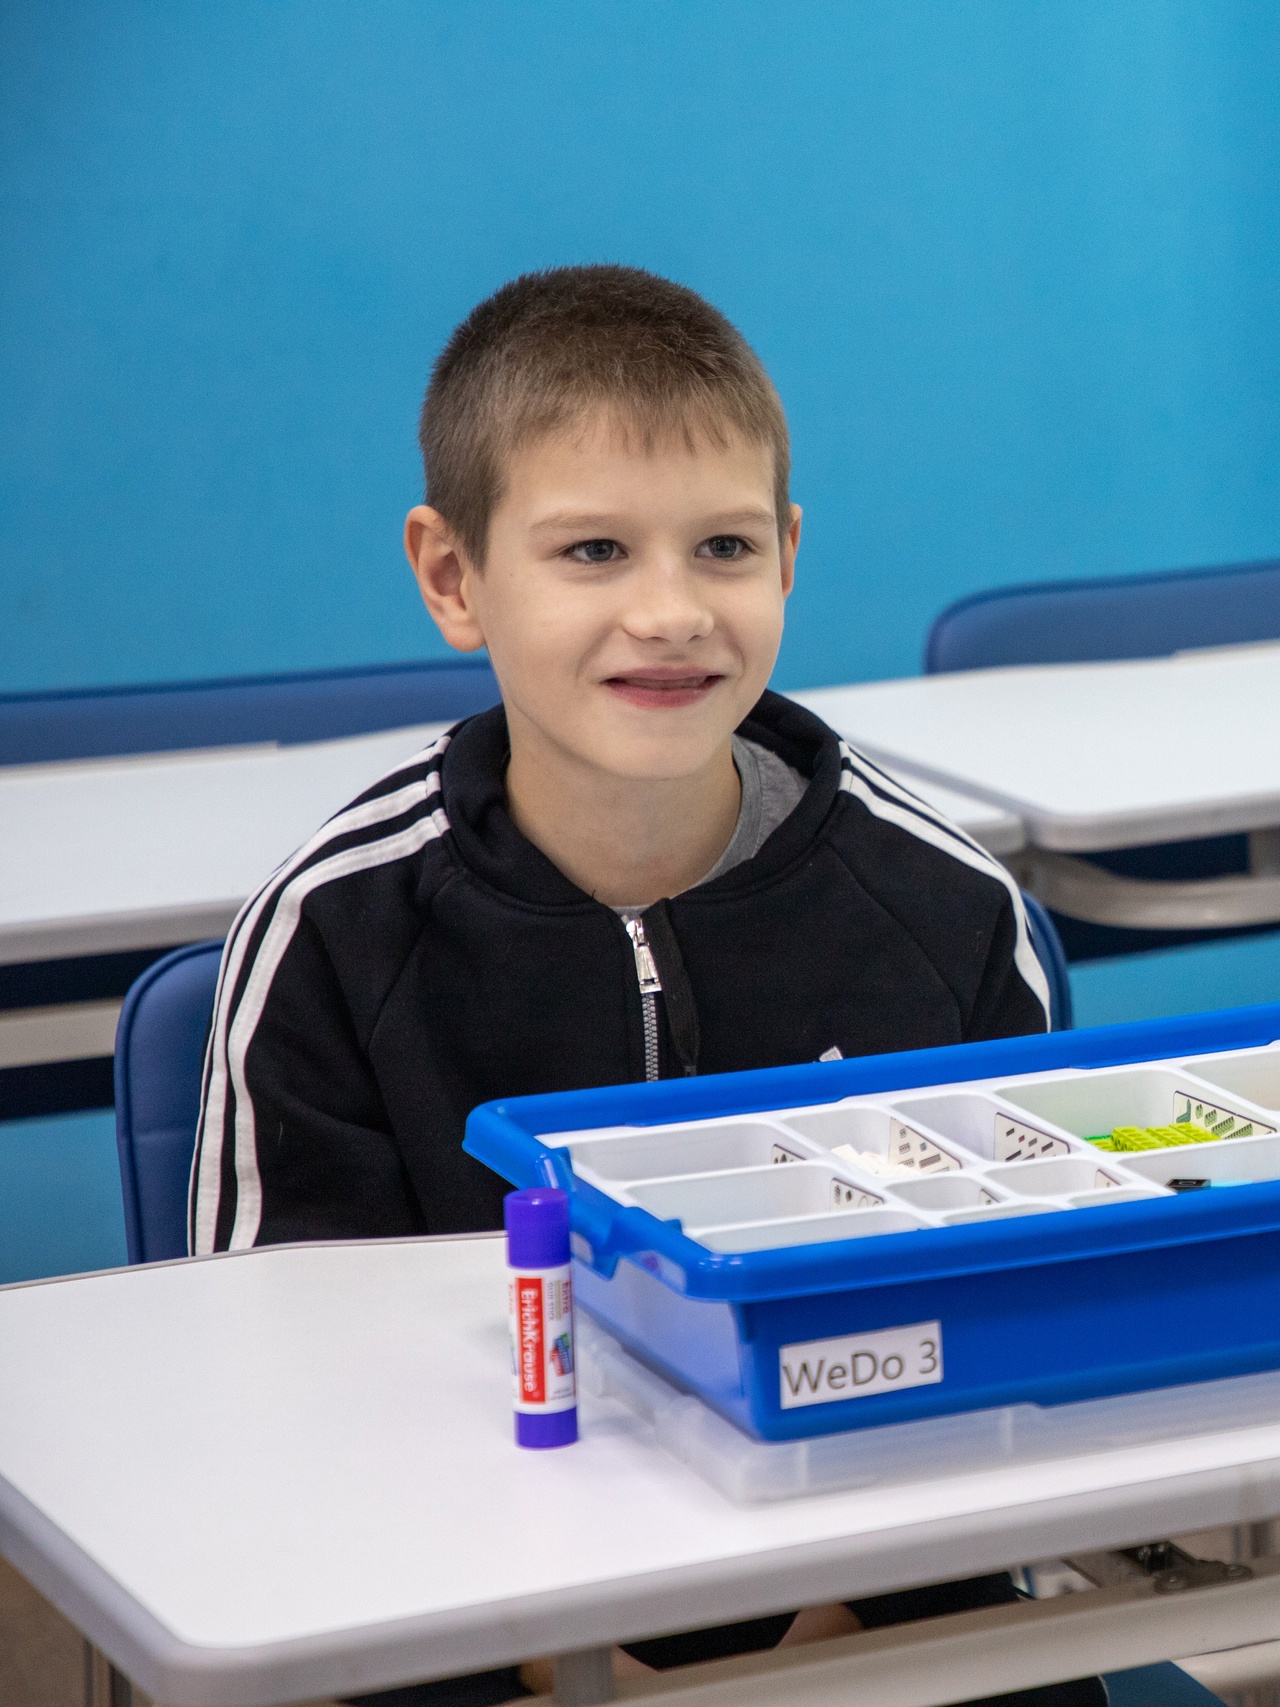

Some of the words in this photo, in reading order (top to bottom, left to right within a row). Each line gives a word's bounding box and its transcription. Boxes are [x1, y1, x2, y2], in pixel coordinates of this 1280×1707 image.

[520, 1288, 540, 1393] ErichKrause
[782, 1352, 905, 1396] WeDo
[918, 1340, 938, 1375] 3
